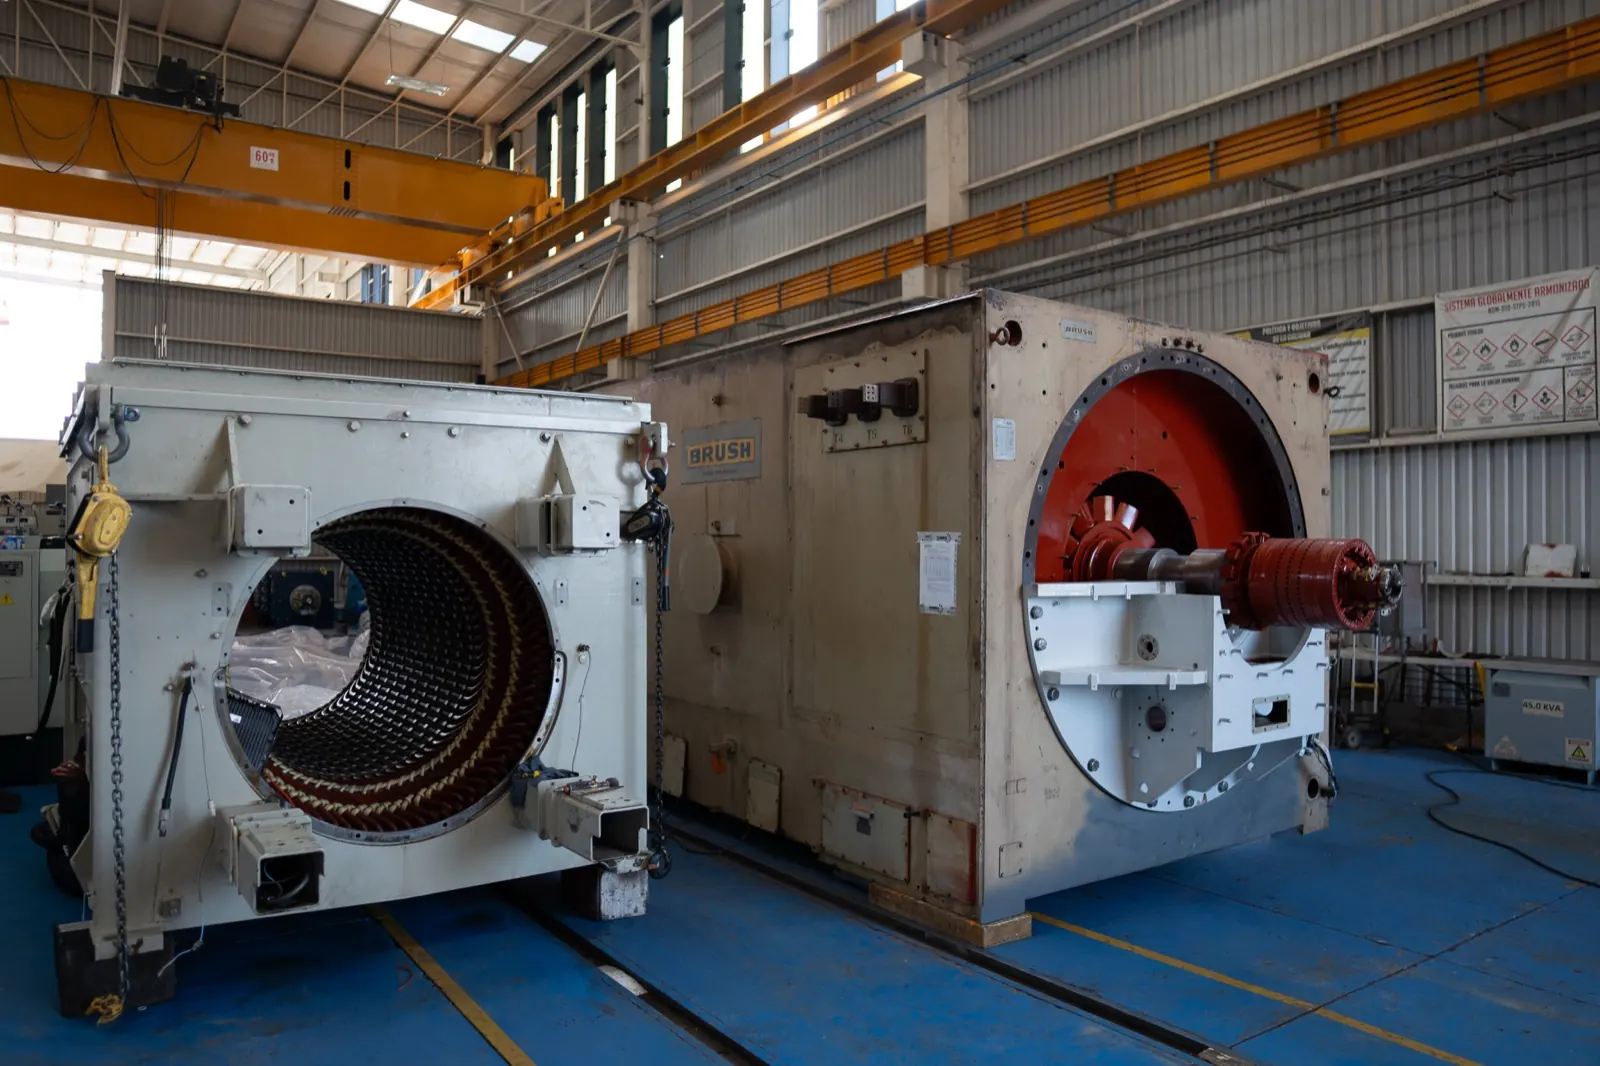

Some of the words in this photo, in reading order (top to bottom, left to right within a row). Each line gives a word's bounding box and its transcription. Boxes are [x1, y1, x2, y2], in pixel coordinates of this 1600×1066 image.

[255, 150, 268, 162] 60
[1444, 297, 1476, 313] SISTEMA
[1477, 288, 1533, 306] GLOBALMENTE
[1534, 278, 1590, 298] ARMONIZADO
[902, 424, 913, 435] T6
[690, 441, 751, 464] BRUSH
[1522, 700, 1541, 710] 45.0
